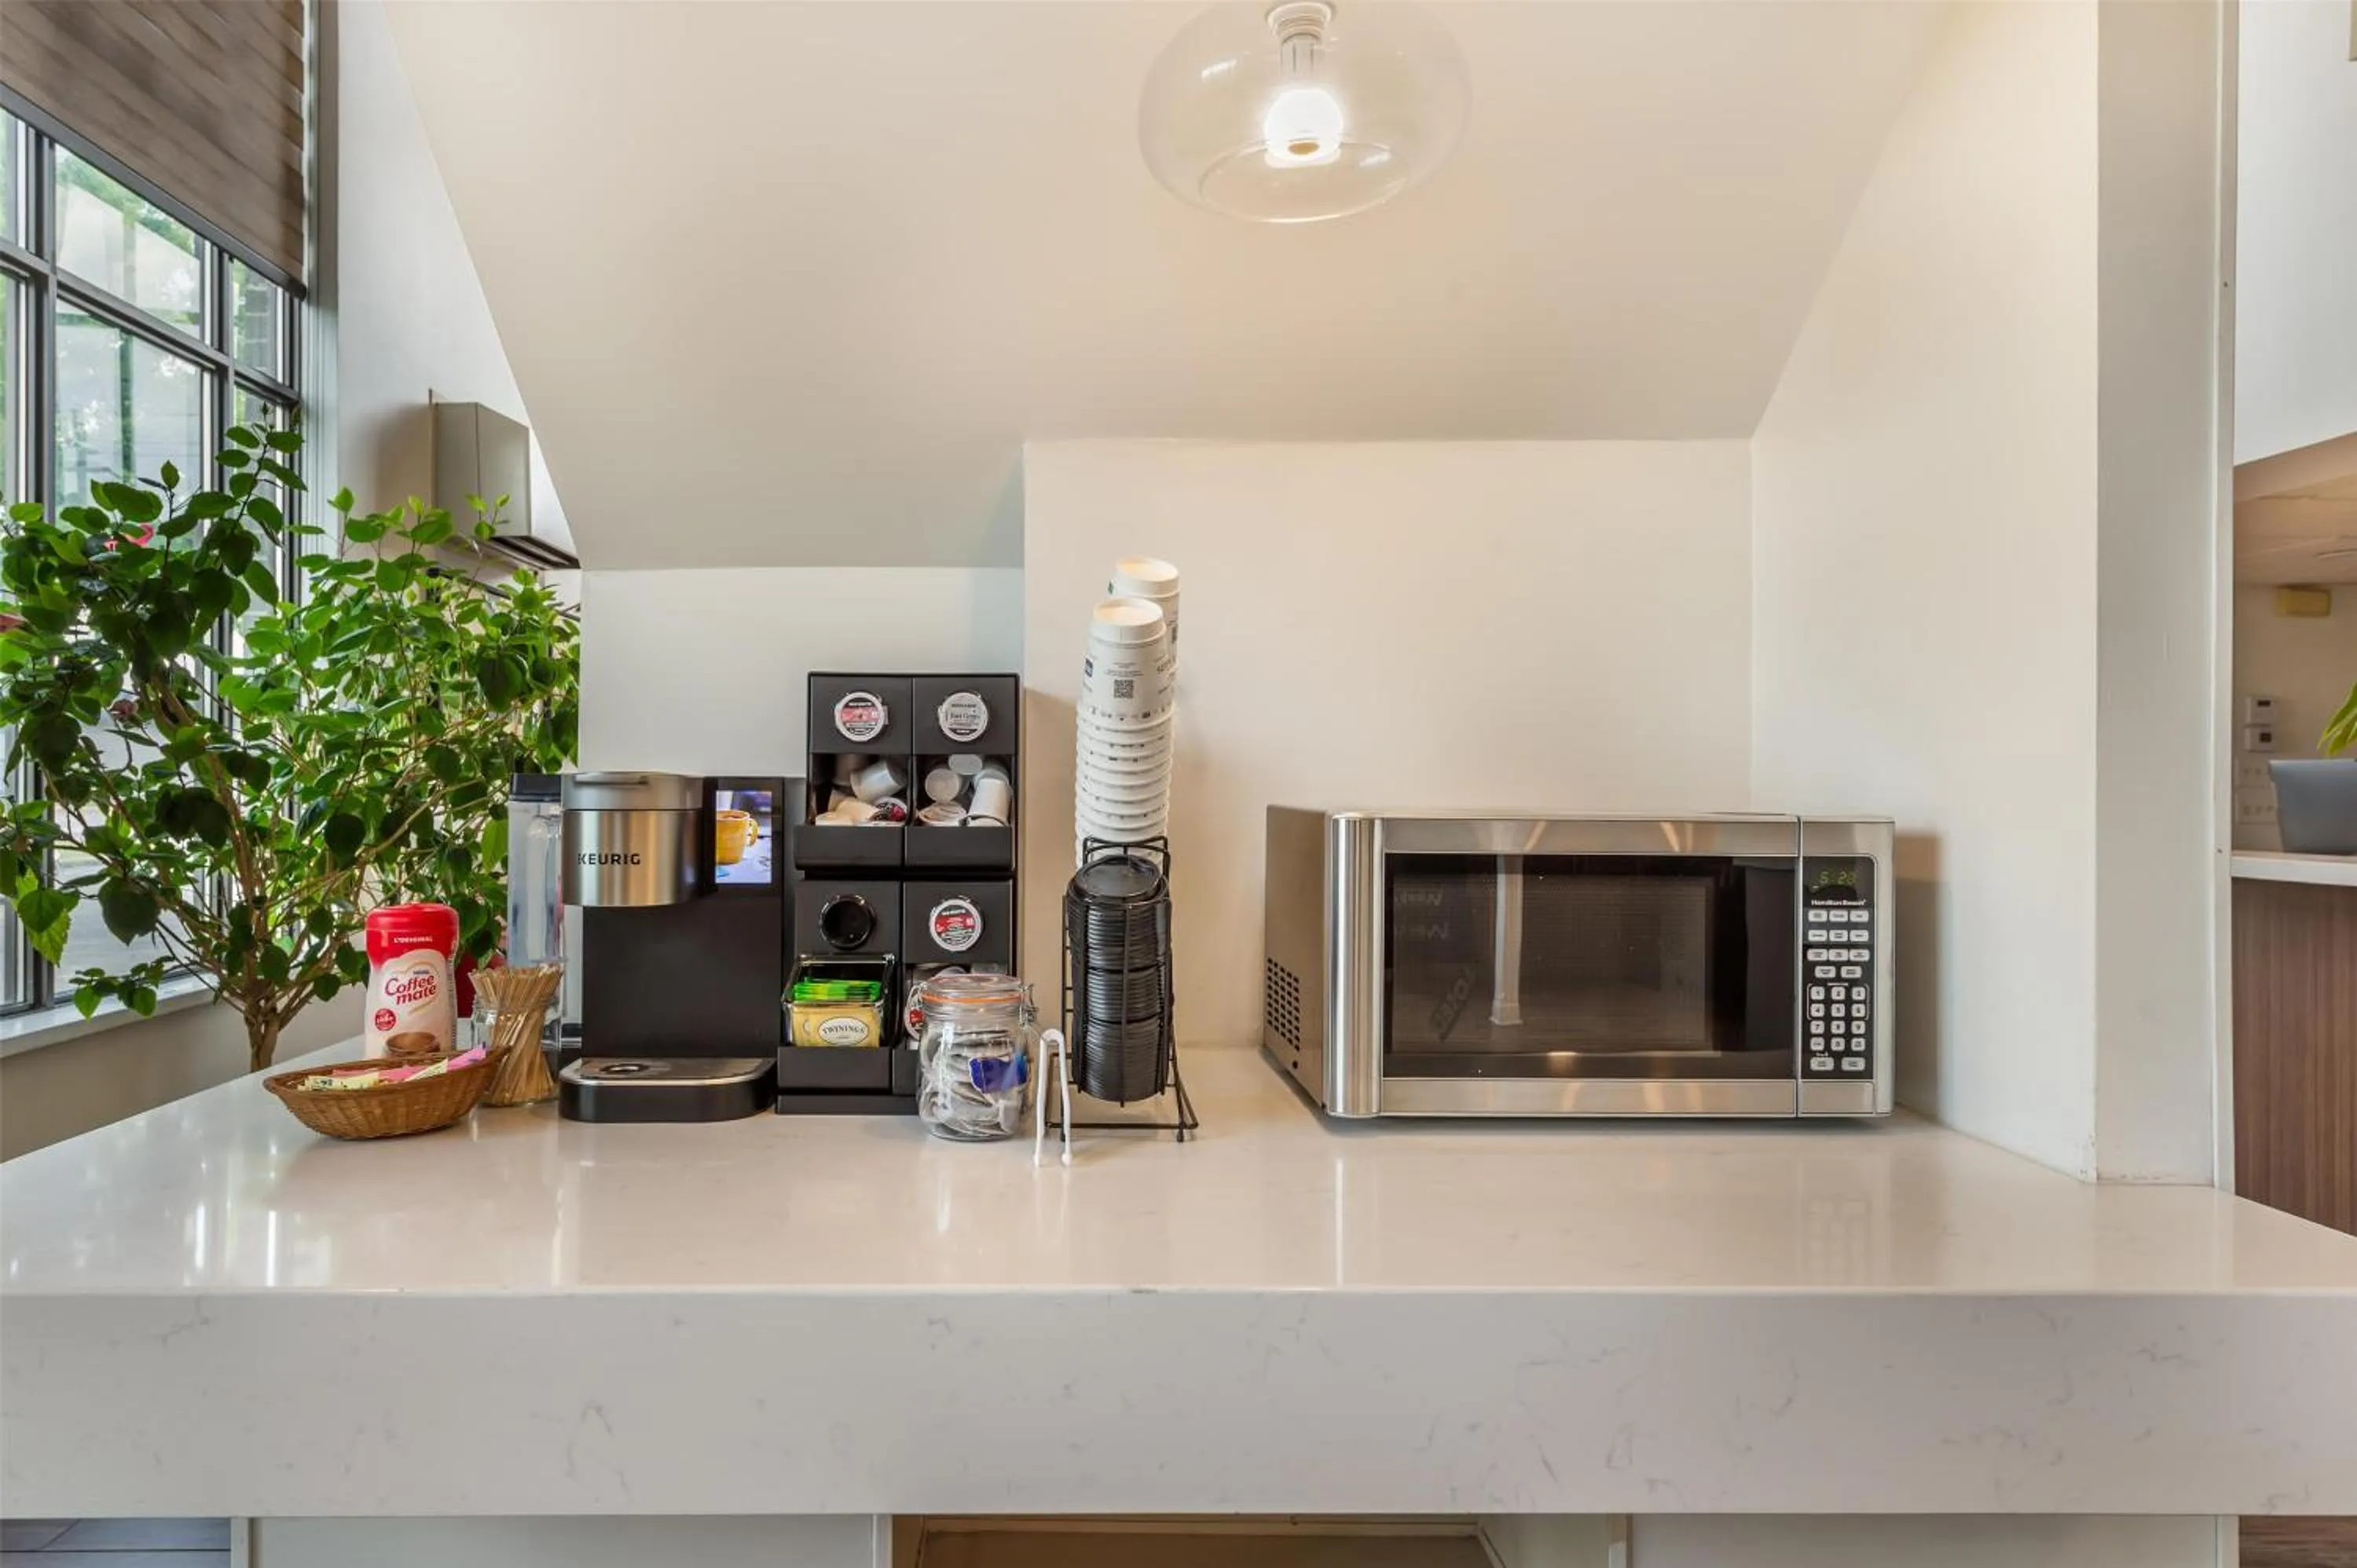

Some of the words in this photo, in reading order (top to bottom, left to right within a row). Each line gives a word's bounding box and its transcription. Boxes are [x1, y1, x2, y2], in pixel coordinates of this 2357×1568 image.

[577, 853, 640, 865] KEURIG
[384, 975, 434, 996] Coffee
[396, 985, 436, 1006] mate
[822, 1024, 865, 1035] TWININGS
